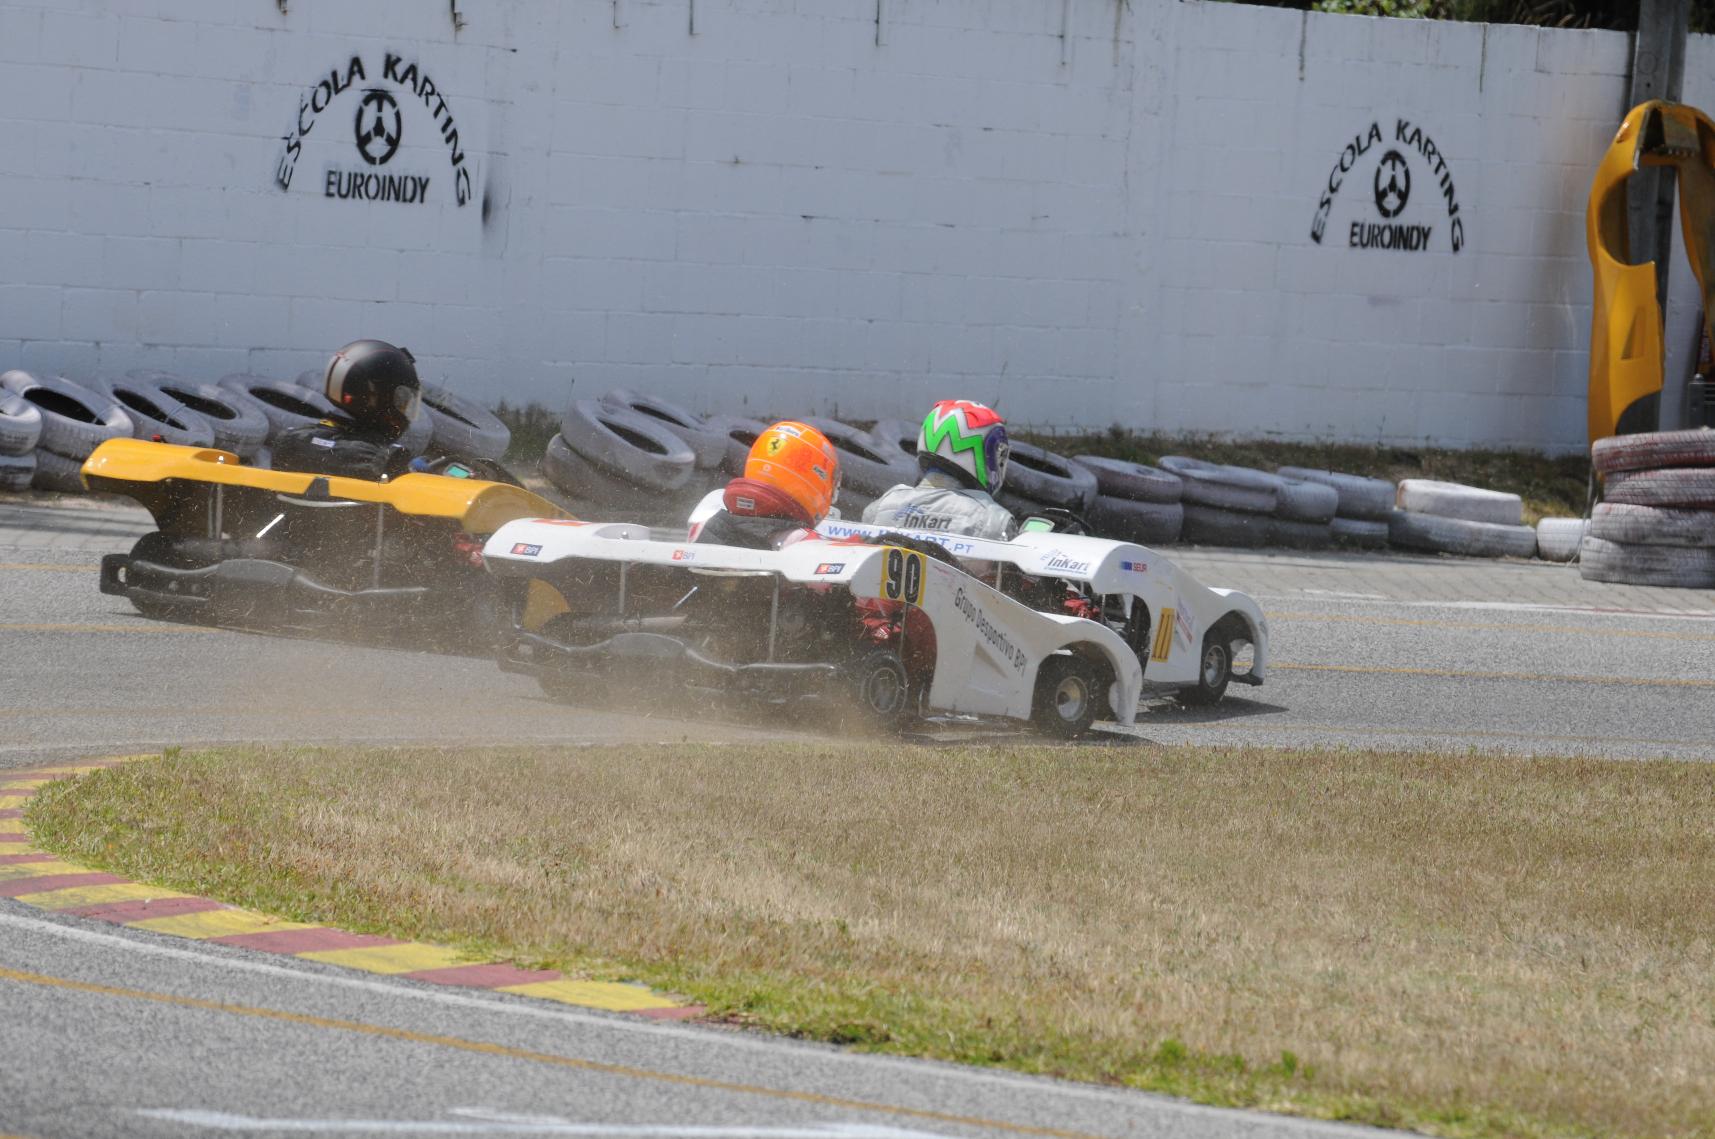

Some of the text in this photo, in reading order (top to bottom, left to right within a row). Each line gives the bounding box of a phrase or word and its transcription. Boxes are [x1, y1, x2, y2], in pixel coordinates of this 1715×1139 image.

[276, 53, 471, 207] ESCOLA KARTING
[325, 170, 430, 204] EUROINDY
[1311, 119, 1464, 252] ESCOLA KARTING
[1350, 222, 1431, 250] EUROINDY
[886, 548, 920, 604] 90
[954, 587, 977, 623] Grupo
[976, 608, 1014, 661] Desportivo
